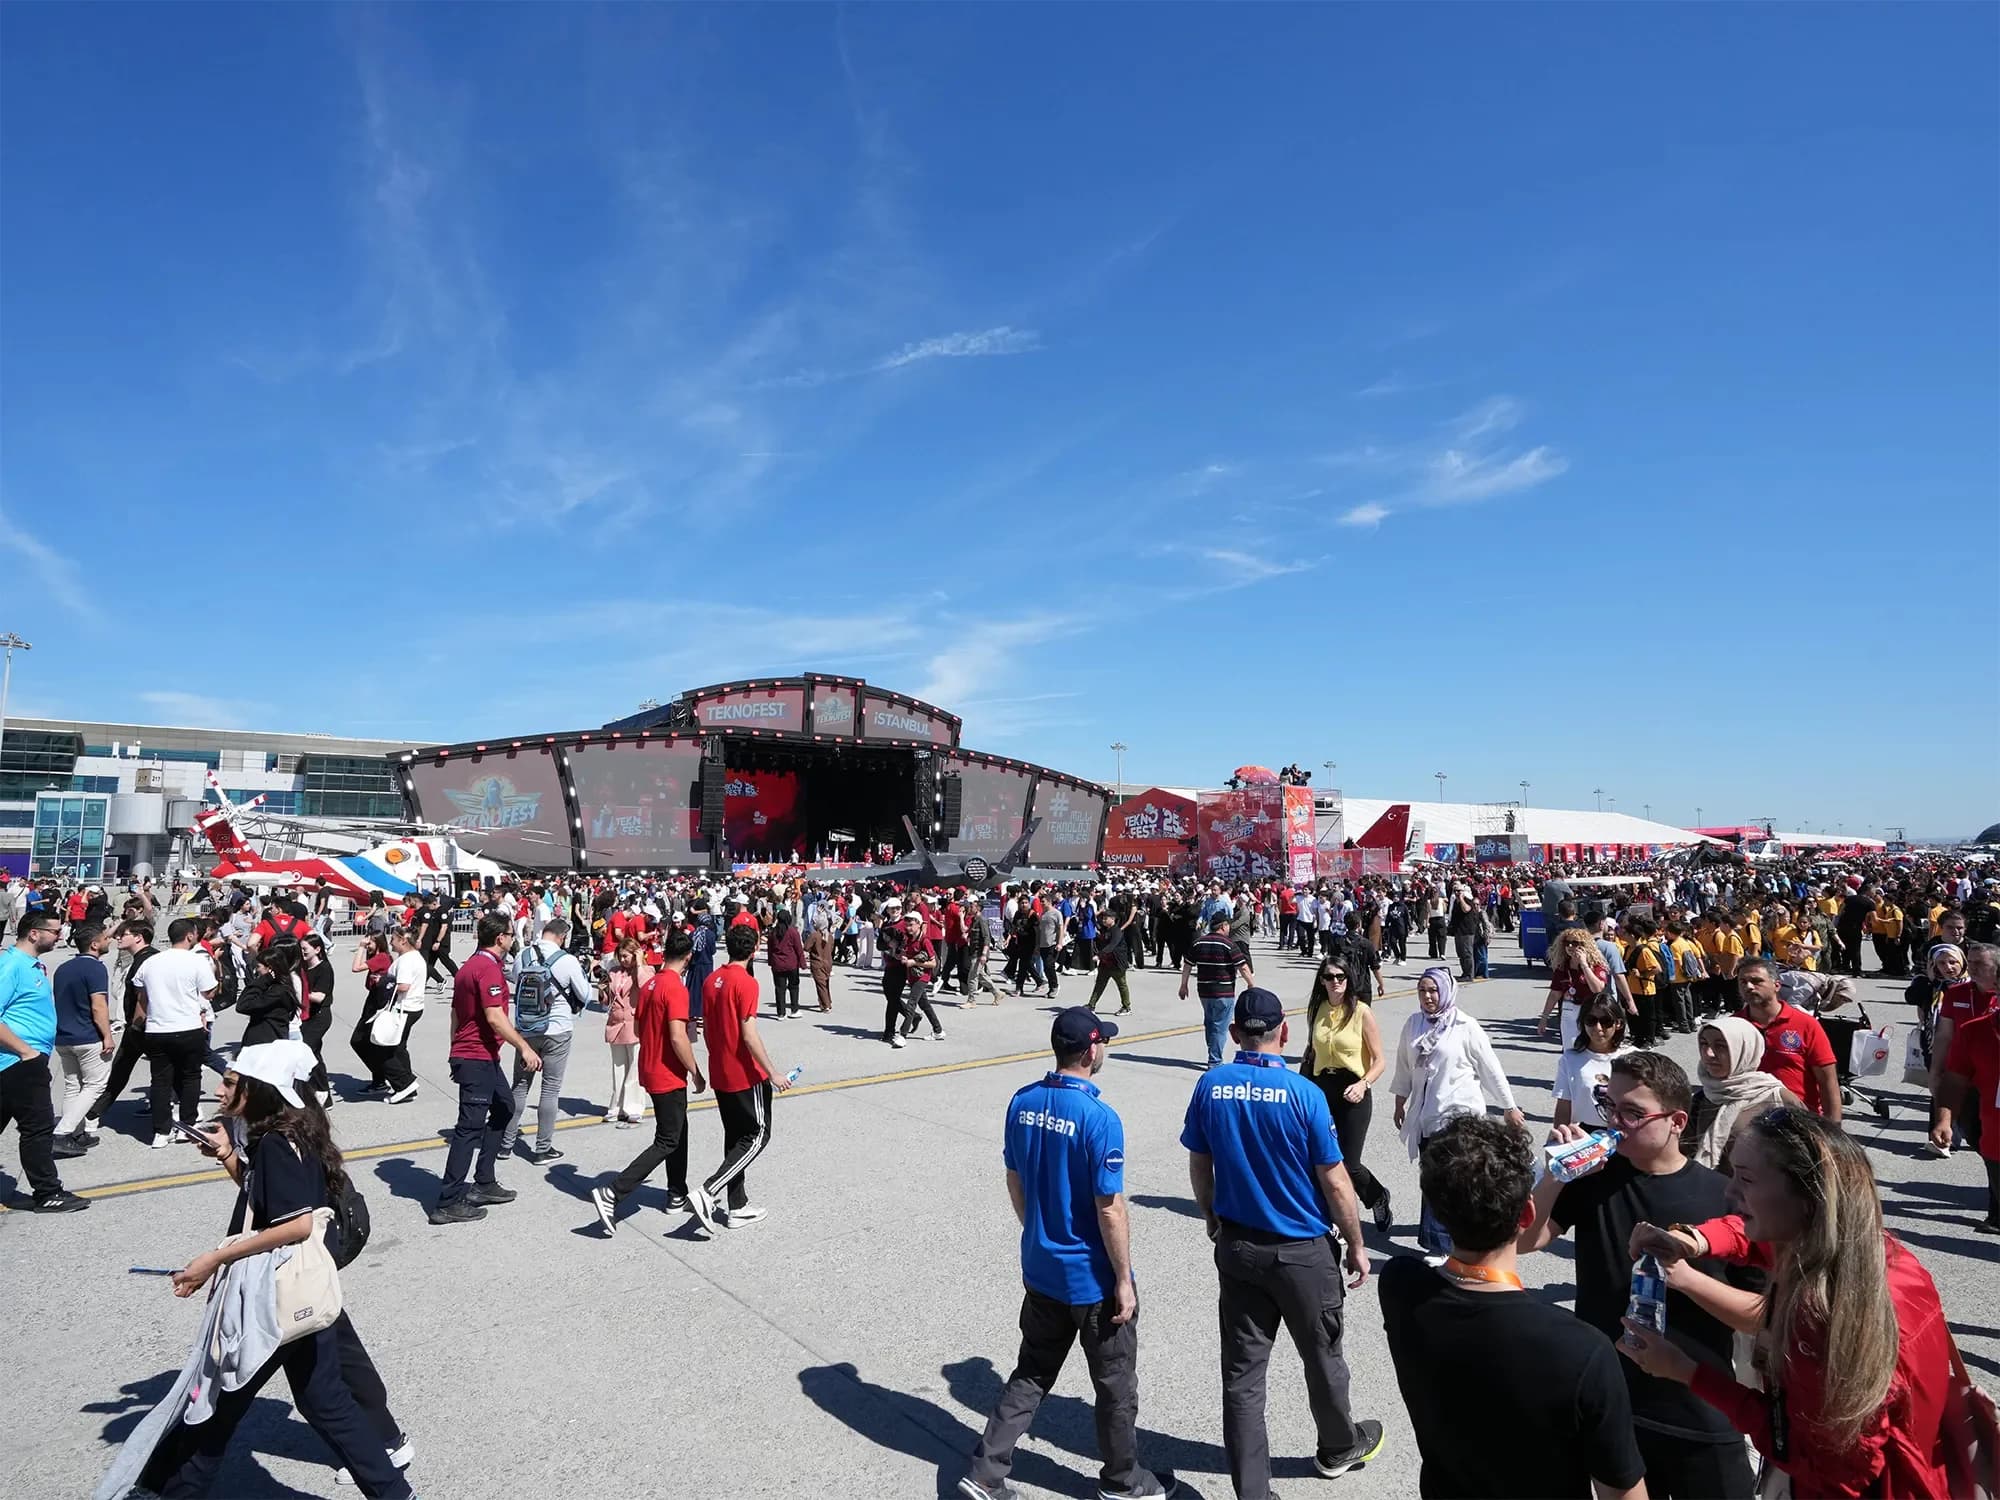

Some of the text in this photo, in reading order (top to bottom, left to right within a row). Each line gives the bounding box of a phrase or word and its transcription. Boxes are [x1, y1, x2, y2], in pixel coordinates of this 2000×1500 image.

[706, 702, 786, 721] TEKNOFEST
[1124, 806, 1158, 828] TEKNO
[1130, 824, 1157, 839] FEST
[1208, 848, 1246, 869] TEKNO
[1212, 1081, 1287, 1104] aselsan
[1018, 1109, 1076, 1137] aselsan
